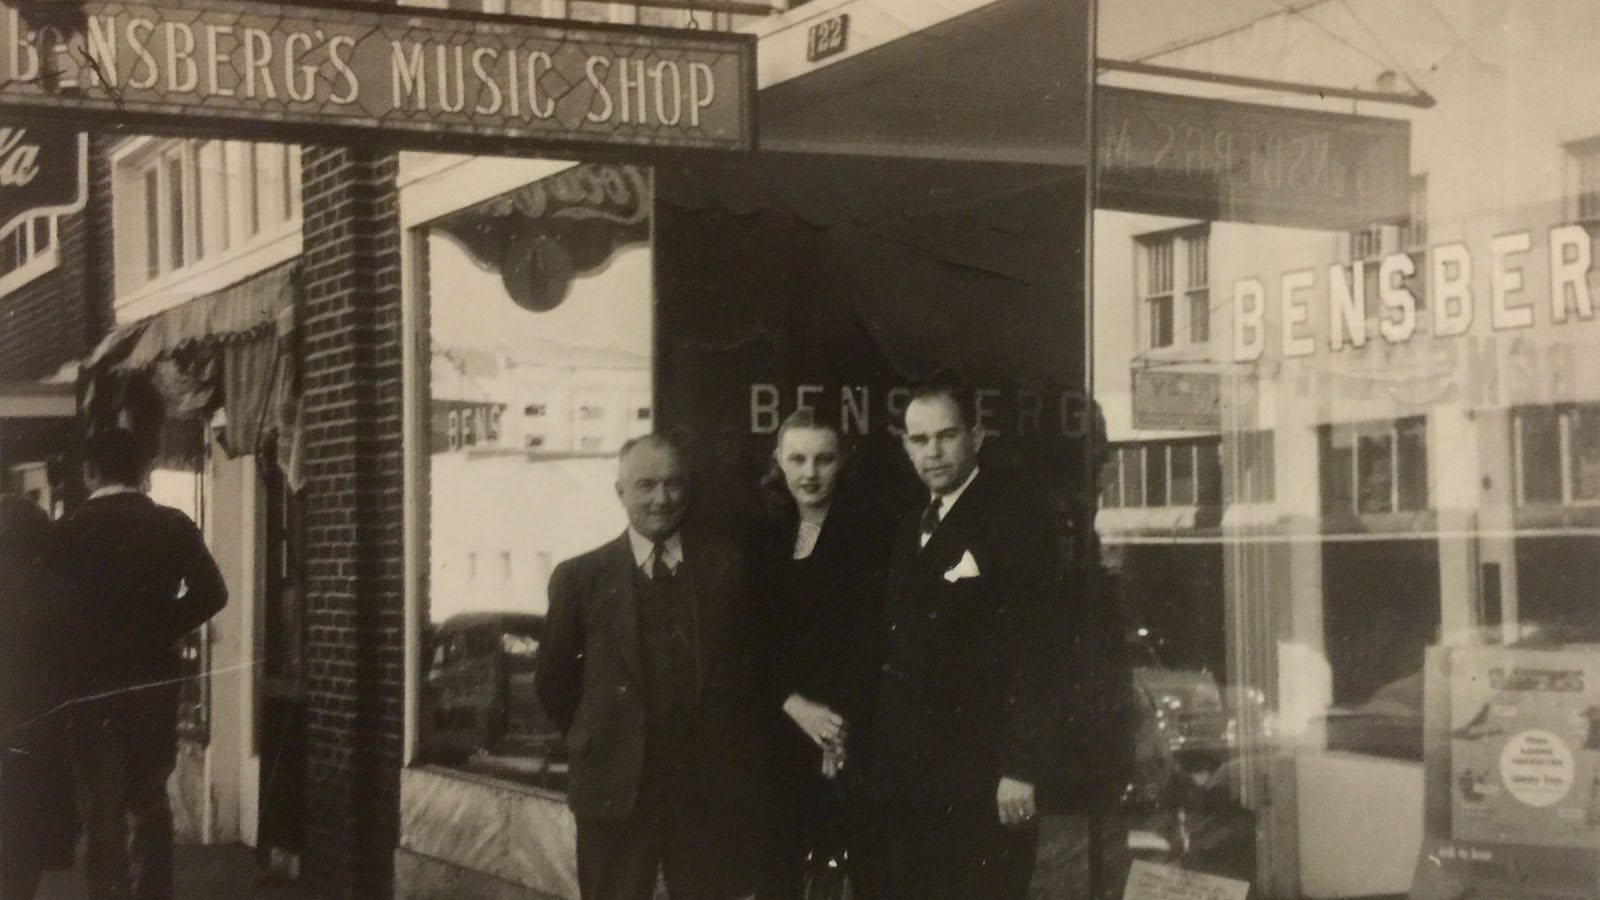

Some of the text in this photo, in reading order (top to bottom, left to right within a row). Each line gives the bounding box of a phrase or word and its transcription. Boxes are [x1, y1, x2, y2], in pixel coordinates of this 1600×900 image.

[391, 40, 554, 118] MUSIC
[585, 54, 715, 127] SHOP
[1233, 224, 1593, 363] BENSBER
[750, 383, 1088, 440] BENSERG
